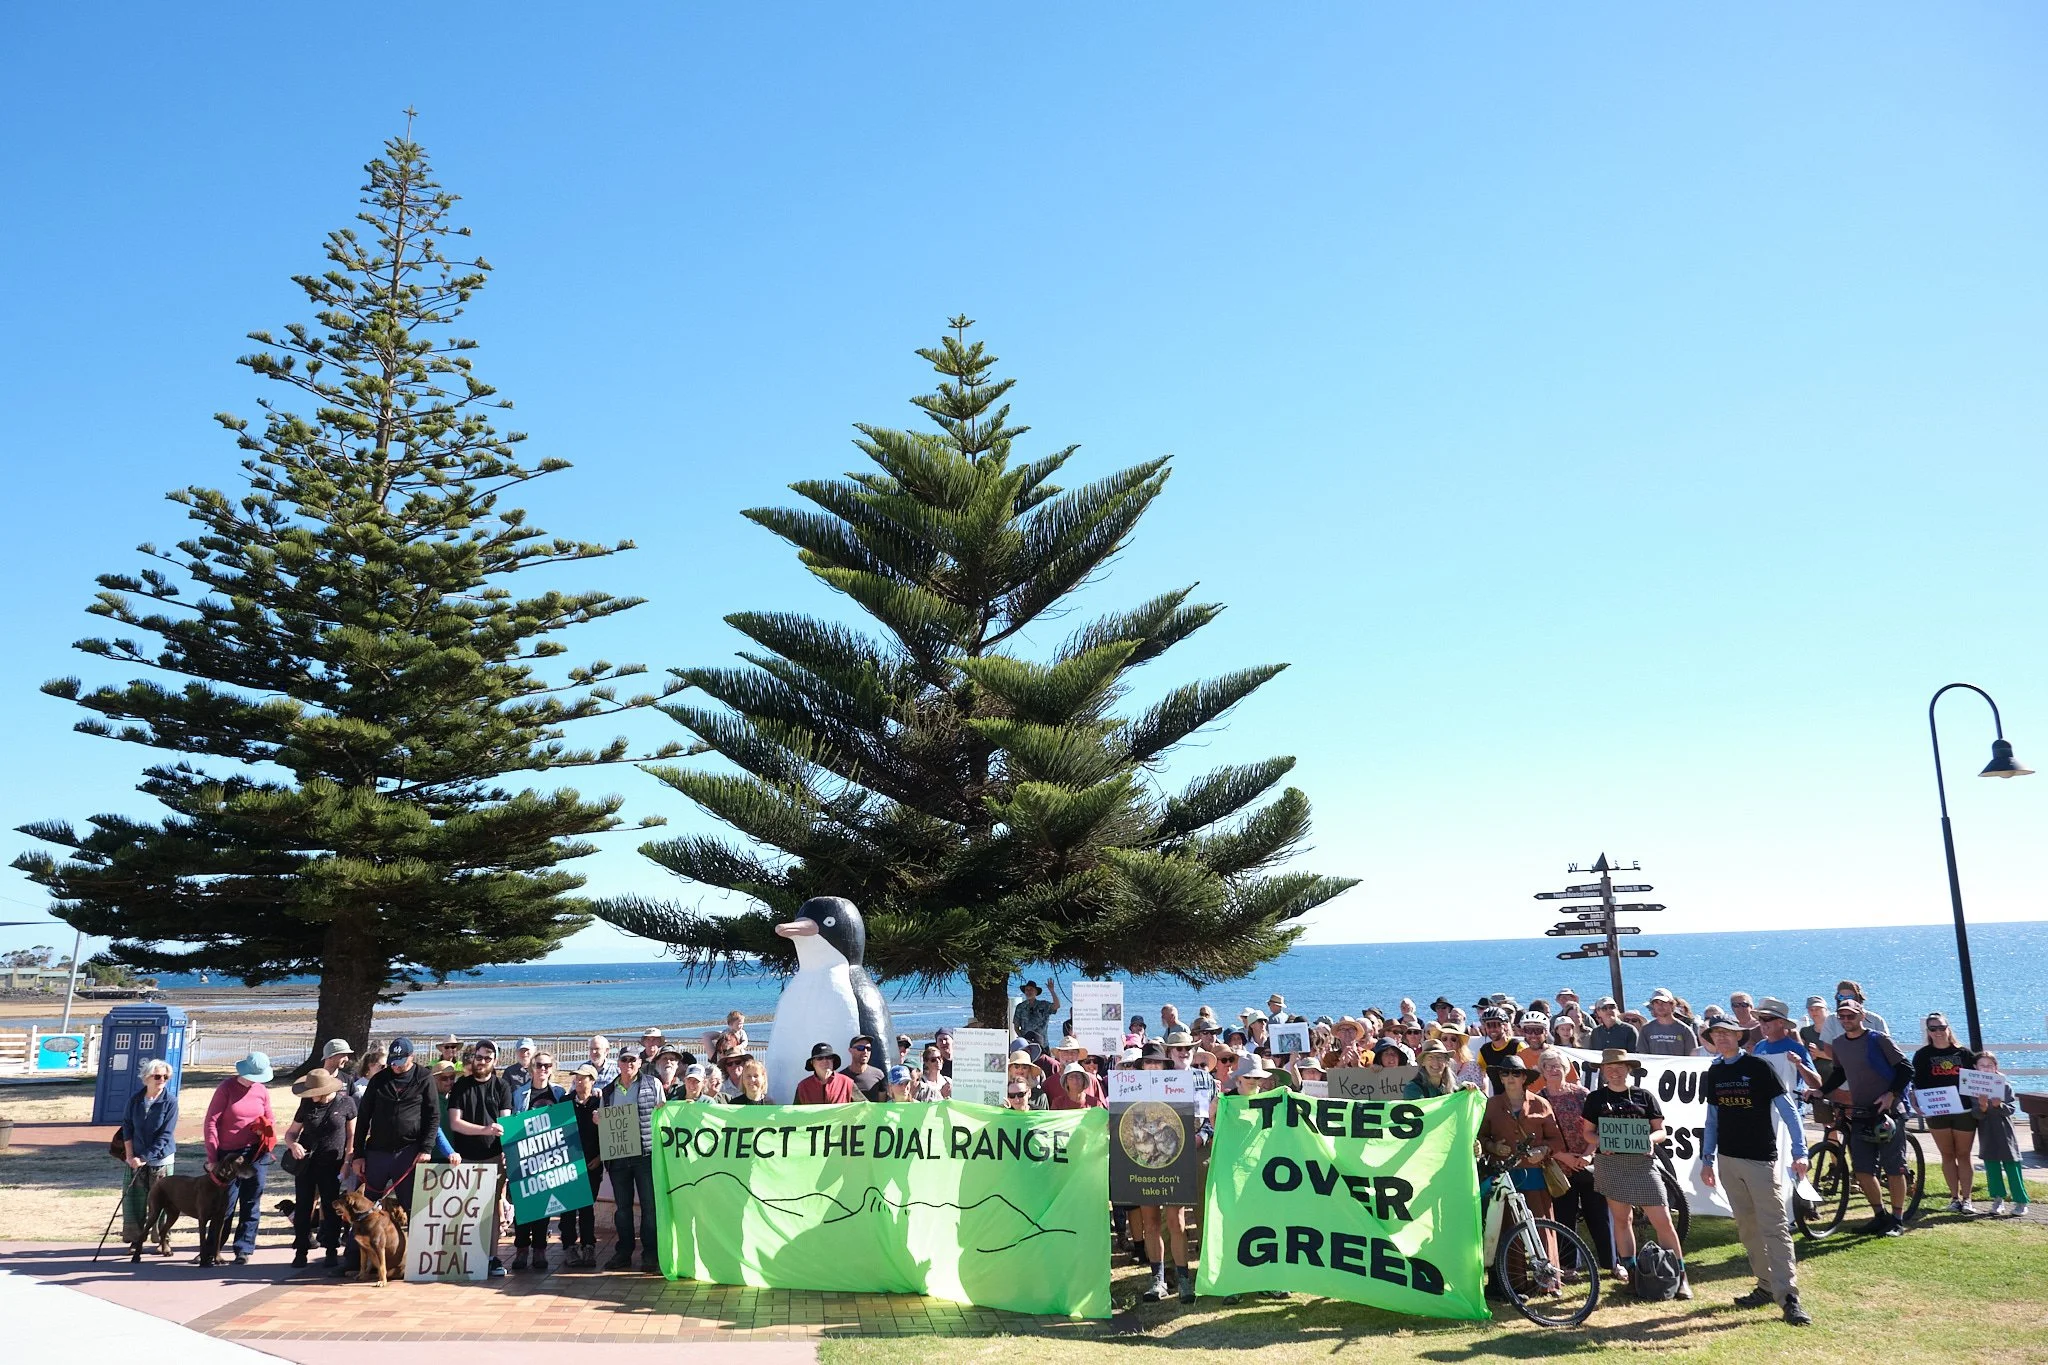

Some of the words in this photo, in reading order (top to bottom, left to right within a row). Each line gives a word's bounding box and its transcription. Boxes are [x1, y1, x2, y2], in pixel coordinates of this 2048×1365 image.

[1113, 1072, 1136, 1084] This
[1338, 1076, 1375, 1100] Keep
[1379, 1077, 1406, 1095] that
[1119, 1084, 1143, 1097] forest
[1164, 1084, 1186, 1095] home
[524, 1112, 551, 1137] END
[609, 1118, 628, 1131] LOG
[1248, 1095, 1424, 1139] TREES
[611, 1130, 629, 1143] THE
[1632, 1124, 1648, 1135] LOG
[517, 1127, 565, 1159] NATIVE
[661, 1126, 796, 1158] PROTECT
[806, 1125, 866, 1158] THE
[873, 1126, 941, 1160] DIAL
[950, 1126, 1070, 1164] RANGE
[1602, 1137, 1620, 1148] THE
[519, 1146, 570, 1178] FOREST
[423, 1166, 488, 1191] DON'T
[520, 1163, 578, 1198] LOGGING
[1129, 1174, 1157, 1183] Please
[1159, 1175, 1180, 1183] don't
[1262, 1156, 1413, 1221] OVER
[1142, 1187, 1160, 1195] take
[429, 1196, 480, 1218] LOG
[424, 1224, 474, 1246] THE
[418, 1252, 474, 1275] DIAL
[1237, 1226, 1444, 1296] GREED
